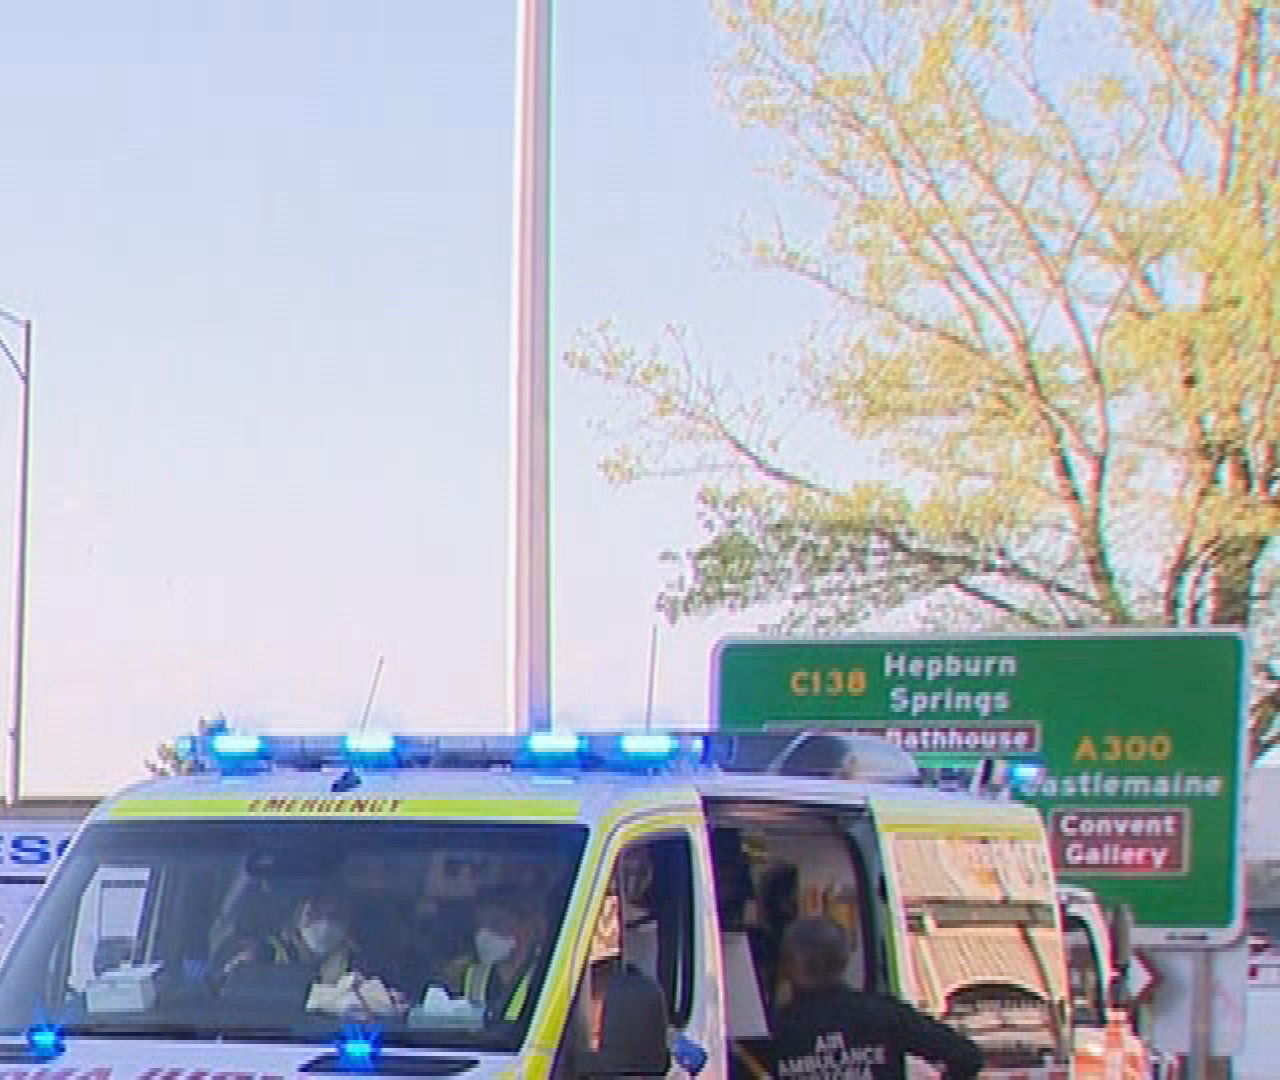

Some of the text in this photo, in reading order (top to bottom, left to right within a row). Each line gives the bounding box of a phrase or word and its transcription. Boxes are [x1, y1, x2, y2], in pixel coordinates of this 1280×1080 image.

[790, 652, 1018, 696] C138 Hepburn
[890, 687, 1011, 717] Springs
[1075, 735, 1172, 761] A300
[248, 794, 401, 814] EMERGENCY
[1059, 815, 1177, 837] Convent
[1064, 843, 1170, 869] Gallery
